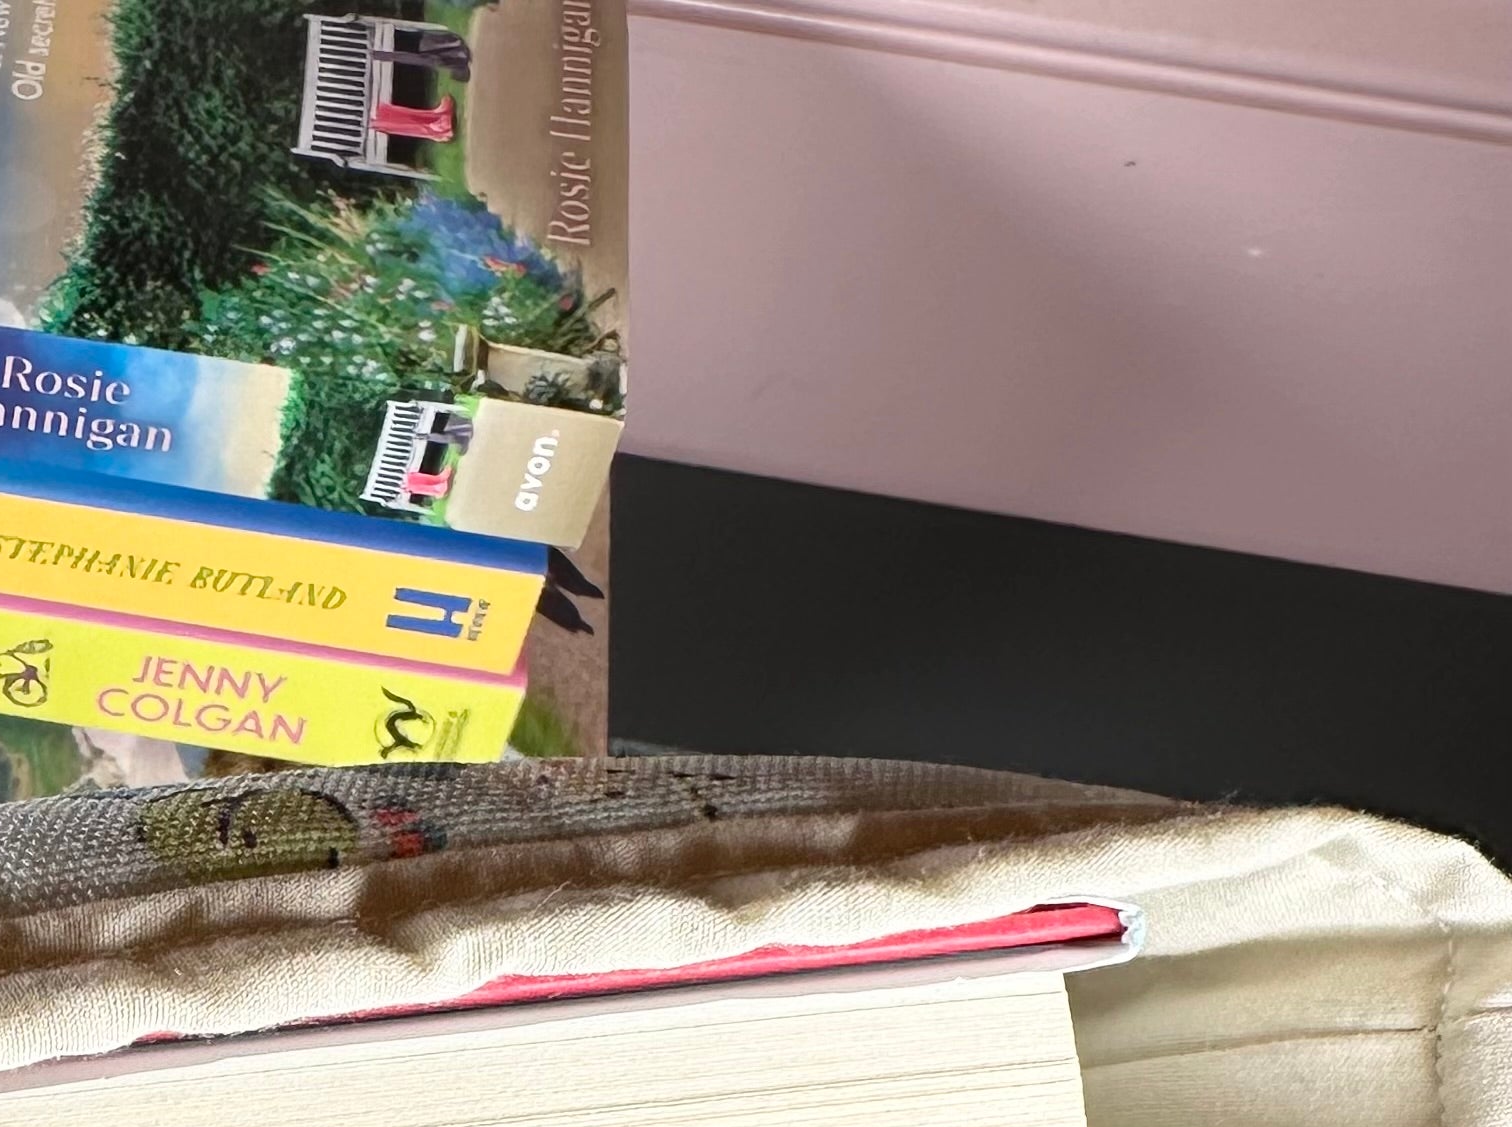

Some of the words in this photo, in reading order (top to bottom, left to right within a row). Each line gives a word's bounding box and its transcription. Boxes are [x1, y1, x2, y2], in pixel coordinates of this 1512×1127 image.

[11, 60, 46, 100] Old
[547, 152, 591, 245] Rosie
[1, 355, 132, 406] Rosie
[190, 566, 349, 611] BUTLAND
[133, 655, 289, 705] JENNY
[97, 687, 308, 746] COLGAN
